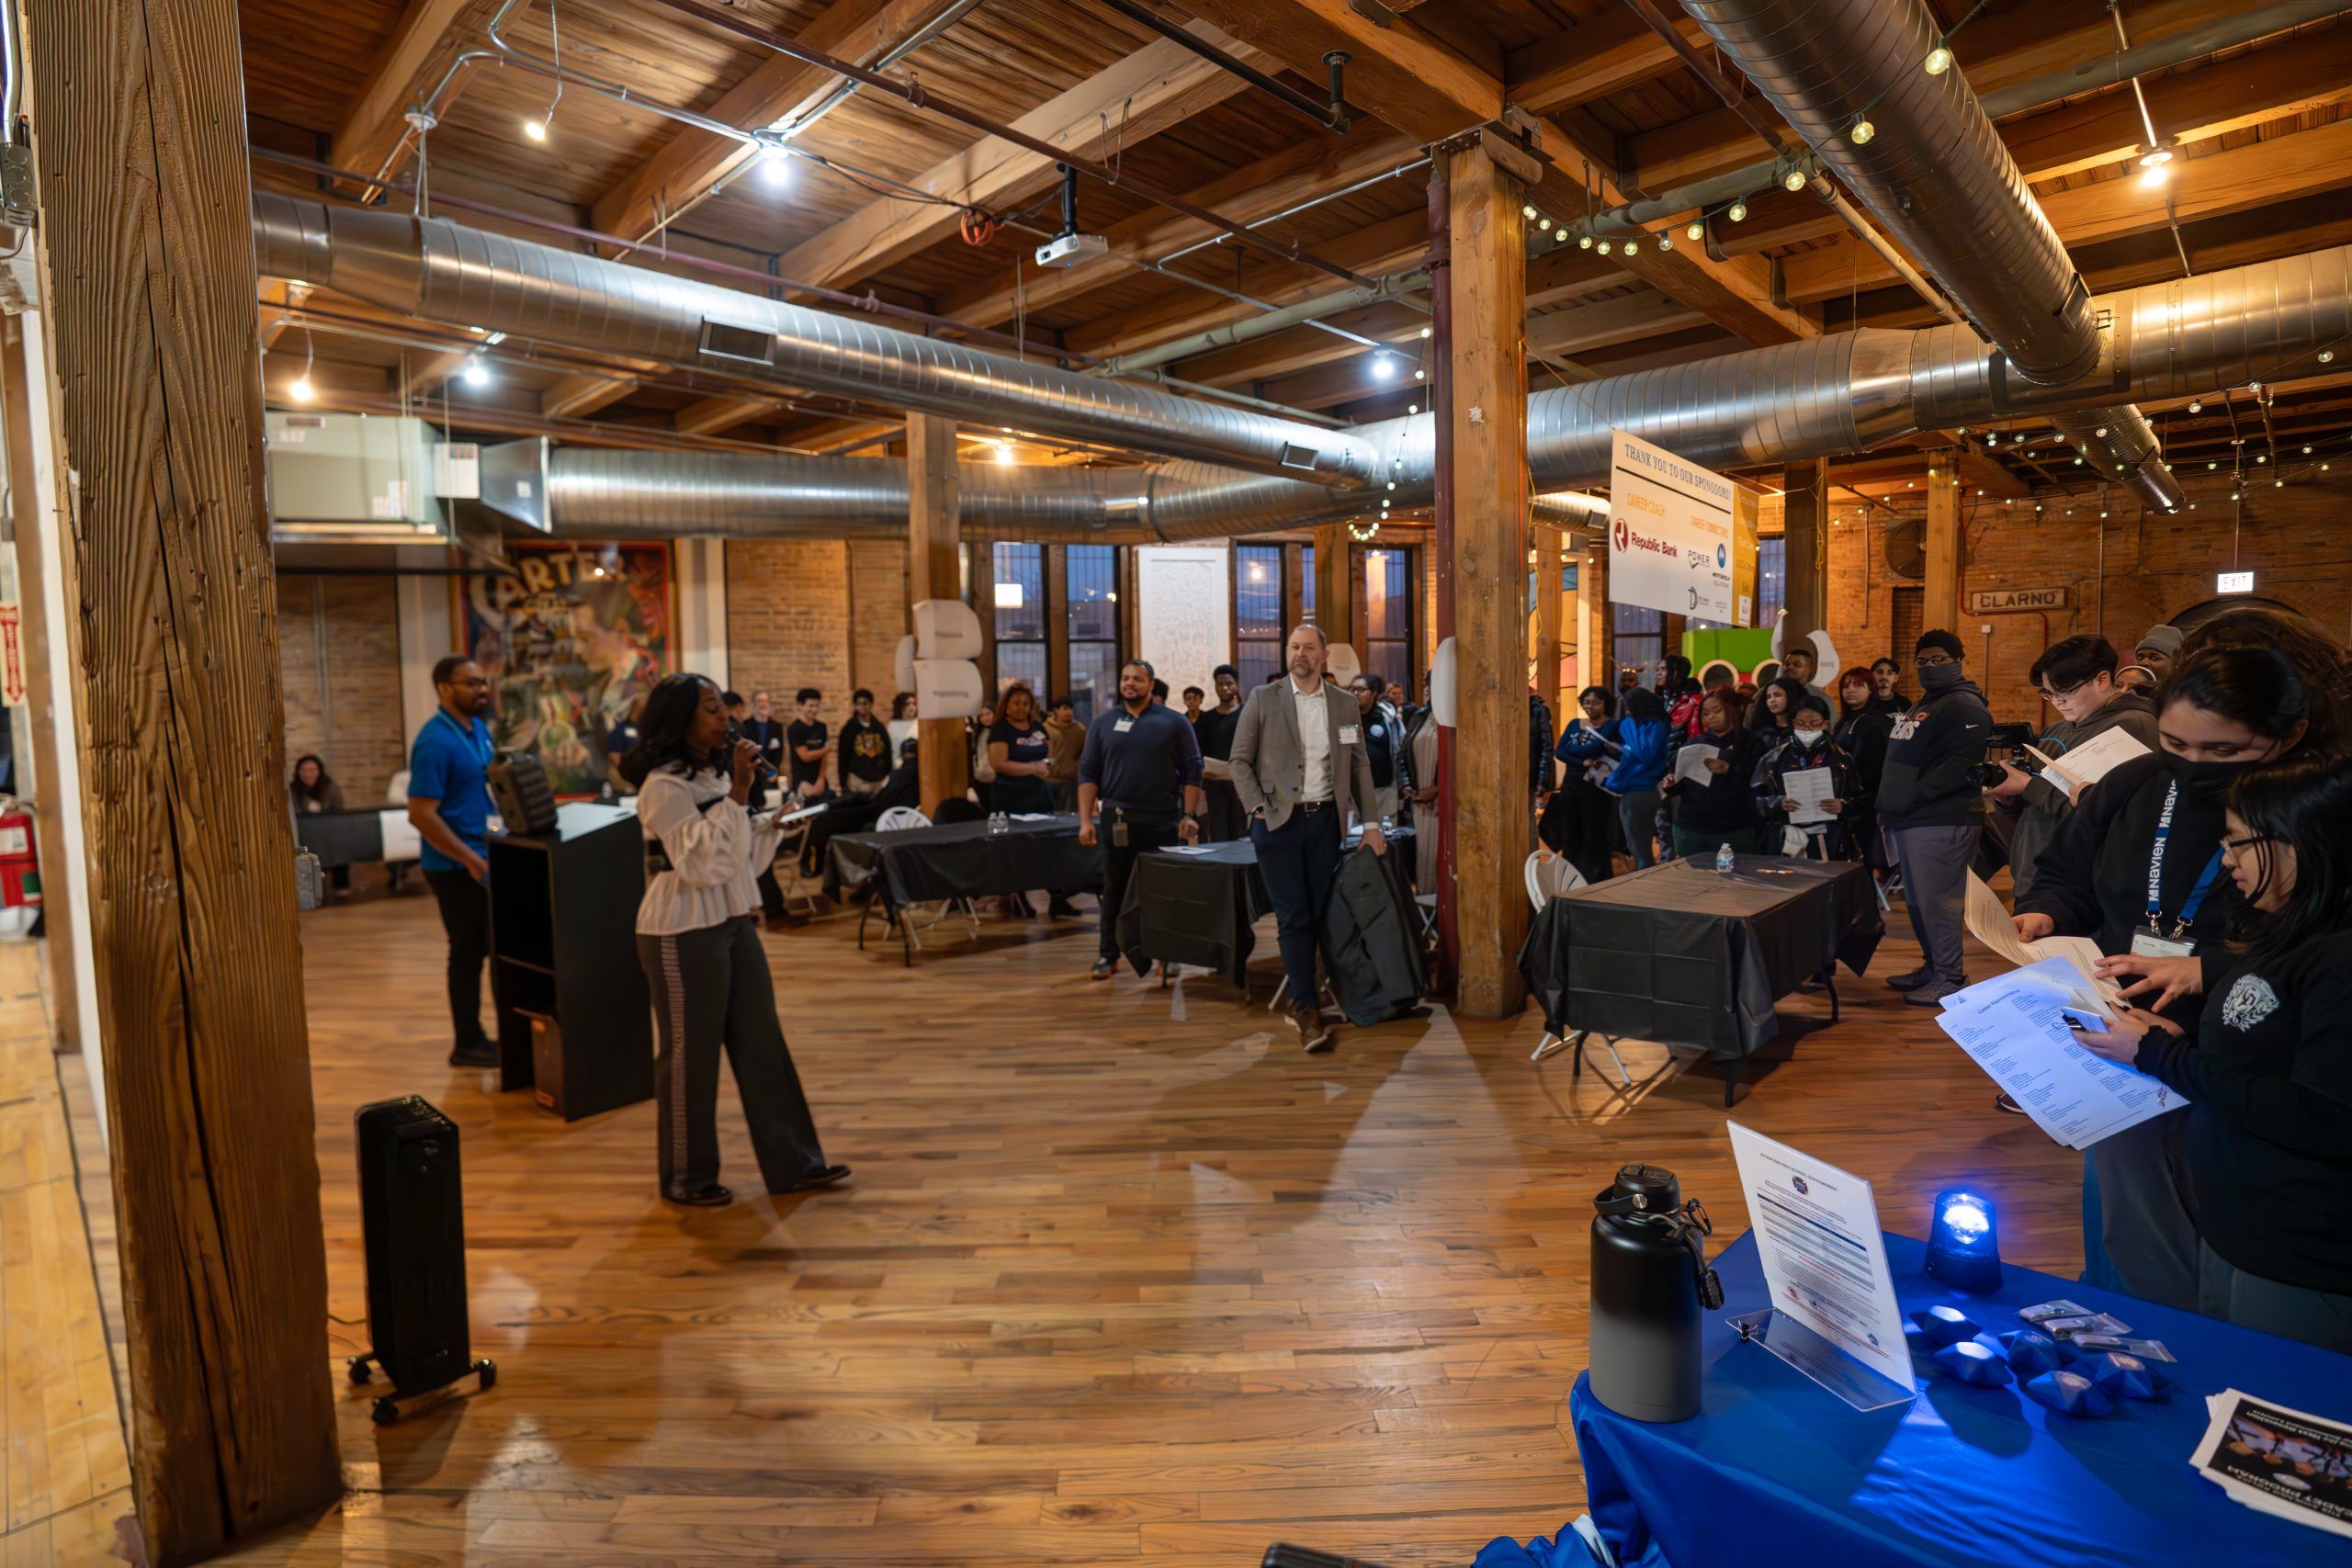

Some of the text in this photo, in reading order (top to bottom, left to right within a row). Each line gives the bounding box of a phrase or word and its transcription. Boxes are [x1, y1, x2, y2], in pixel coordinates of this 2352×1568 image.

[1625, 444, 1651, 467] THANK
[1653, 456, 1668, 474] YOU
[1669, 464, 1679, 478] TO
[1679, 468, 1694, 485] OUR
[1632, 532, 1678, 558] Republic Bank
[2223, 575, 2247, 590] EXIT
[1980, 591, 2056, 608] CLARNO
[2227, 1464, 2301, 1498] PROGRAM
